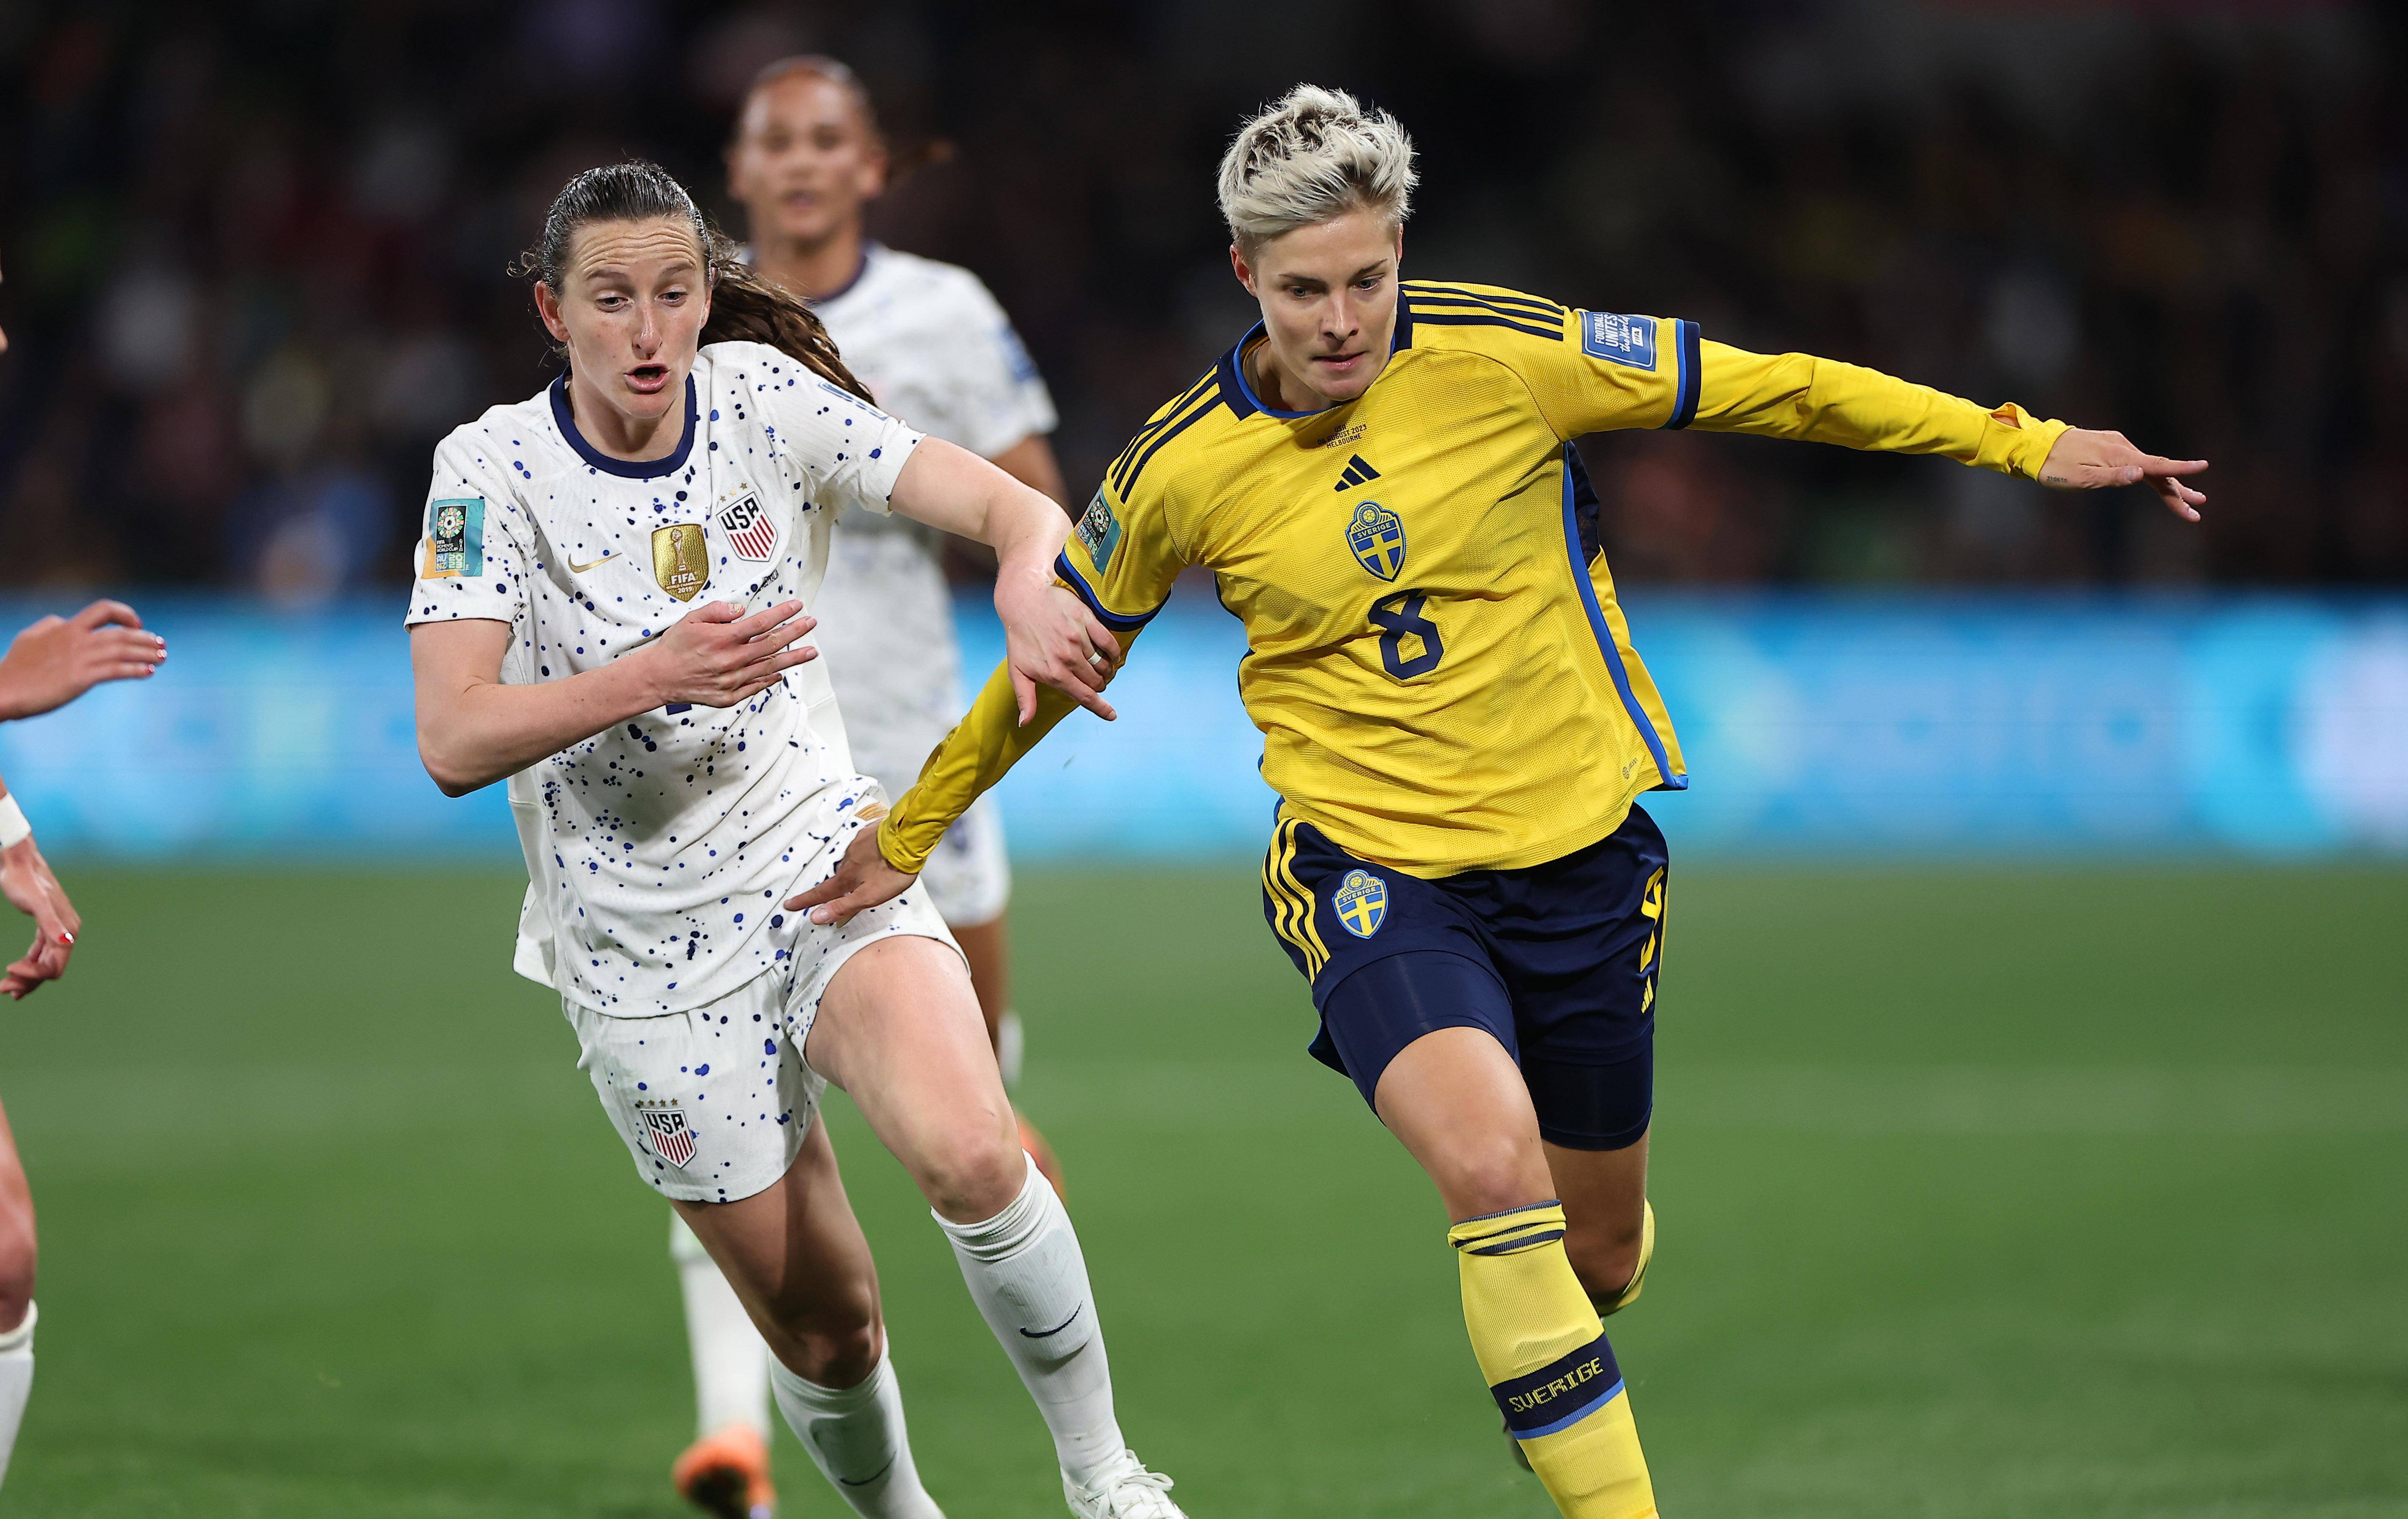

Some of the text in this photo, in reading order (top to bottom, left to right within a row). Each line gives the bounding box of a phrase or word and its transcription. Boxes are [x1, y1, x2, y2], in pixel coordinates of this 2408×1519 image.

[1593, 313, 1605, 344] FOOTBALL
[1604, 313, 1619, 348] UNITES
[1618, 314, 1631, 352] the World
[1327, 430, 1350, 442] AUGUST
[1351, 423, 1367, 434] 2023
[1334, 423, 1346, 432] USA
[1326, 433, 1362, 449] MELBOURNE
[720, 497, 759, 530] USA
[1357, 522, 1391, 538] SVERIGE
[436, 555, 446, 563] AU
[671, 572, 696, 585] FIFA
[1368, 588, 1444, 680] 8
[1342, 887, 1376, 903] SVERIGE
[646, 1113, 684, 1134] USA
[1508, 1357, 1604, 1413] SVERIGE
